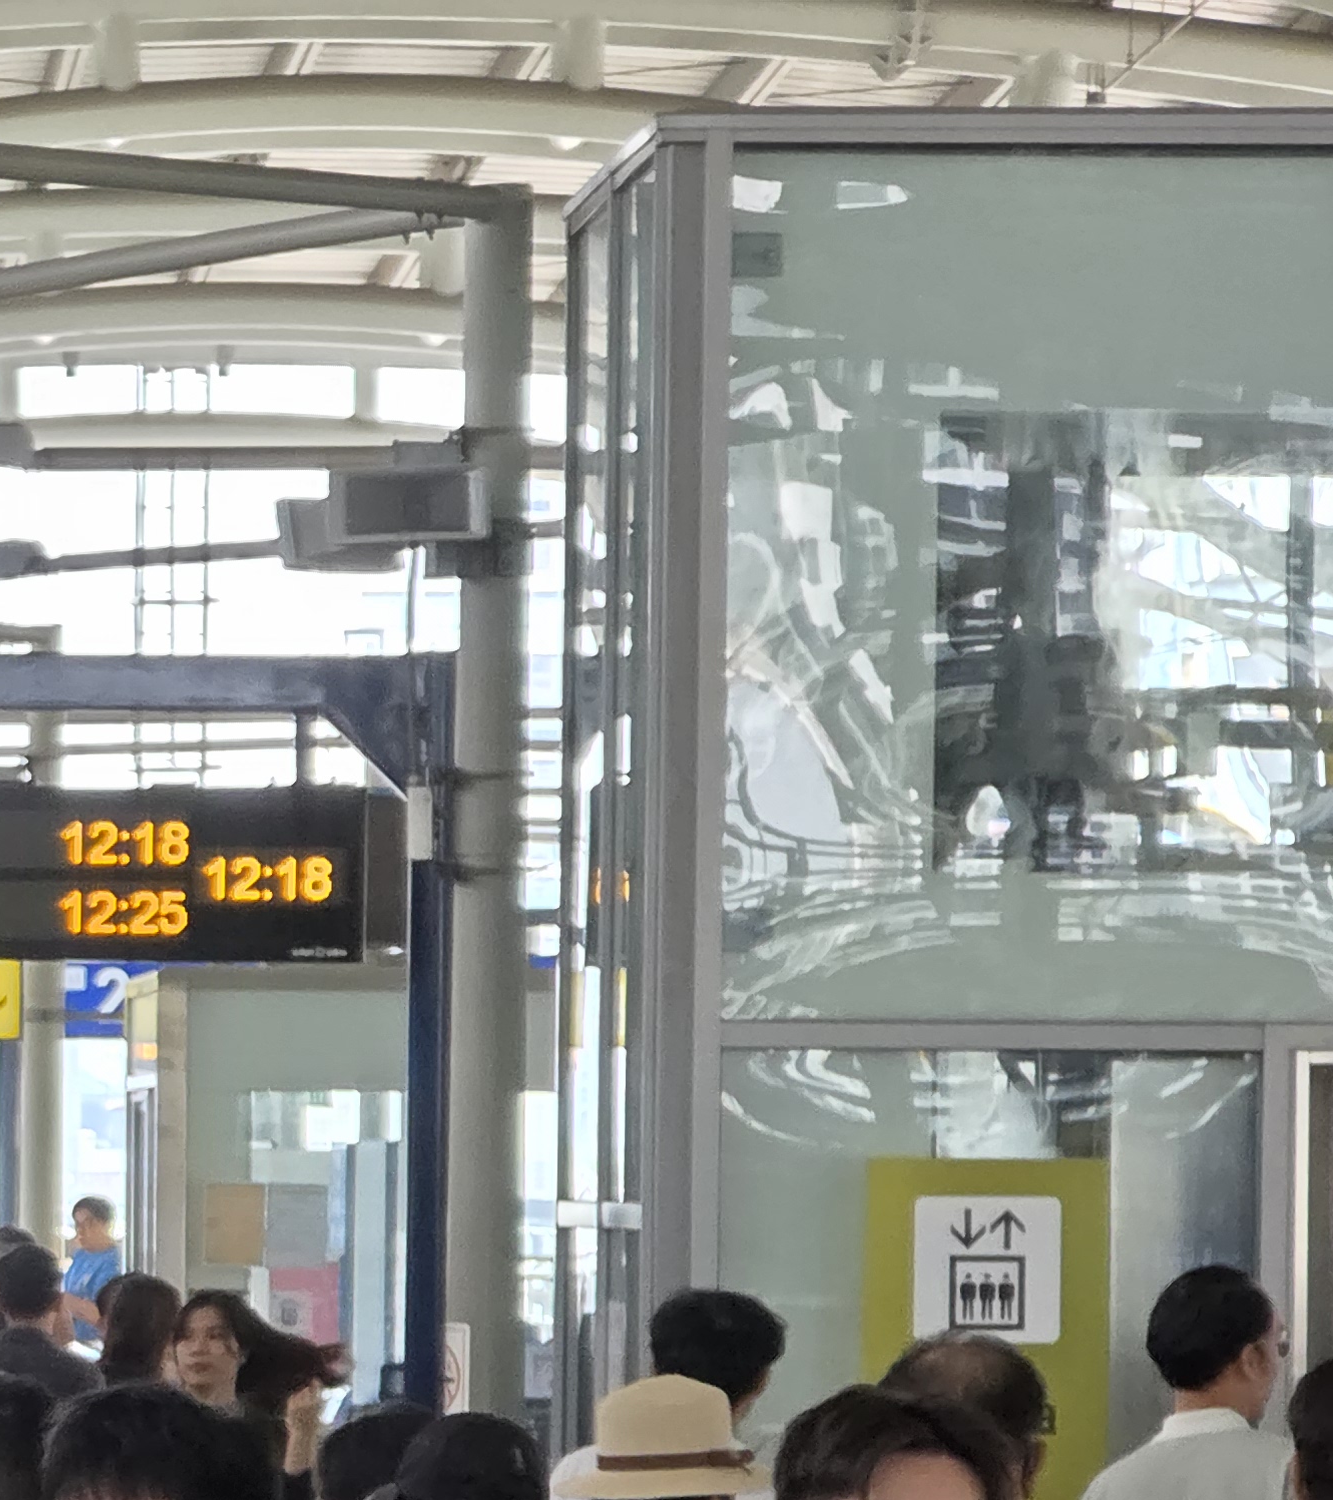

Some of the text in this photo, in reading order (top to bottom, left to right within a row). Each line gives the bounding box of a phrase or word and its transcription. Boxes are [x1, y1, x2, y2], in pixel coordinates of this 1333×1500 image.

[60, 820, 190, 866] 12:18
[202, 855, 333, 902] 12:18
[59, 890, 188, 936] 12:25
[94, 966, 130, 1014] 2
